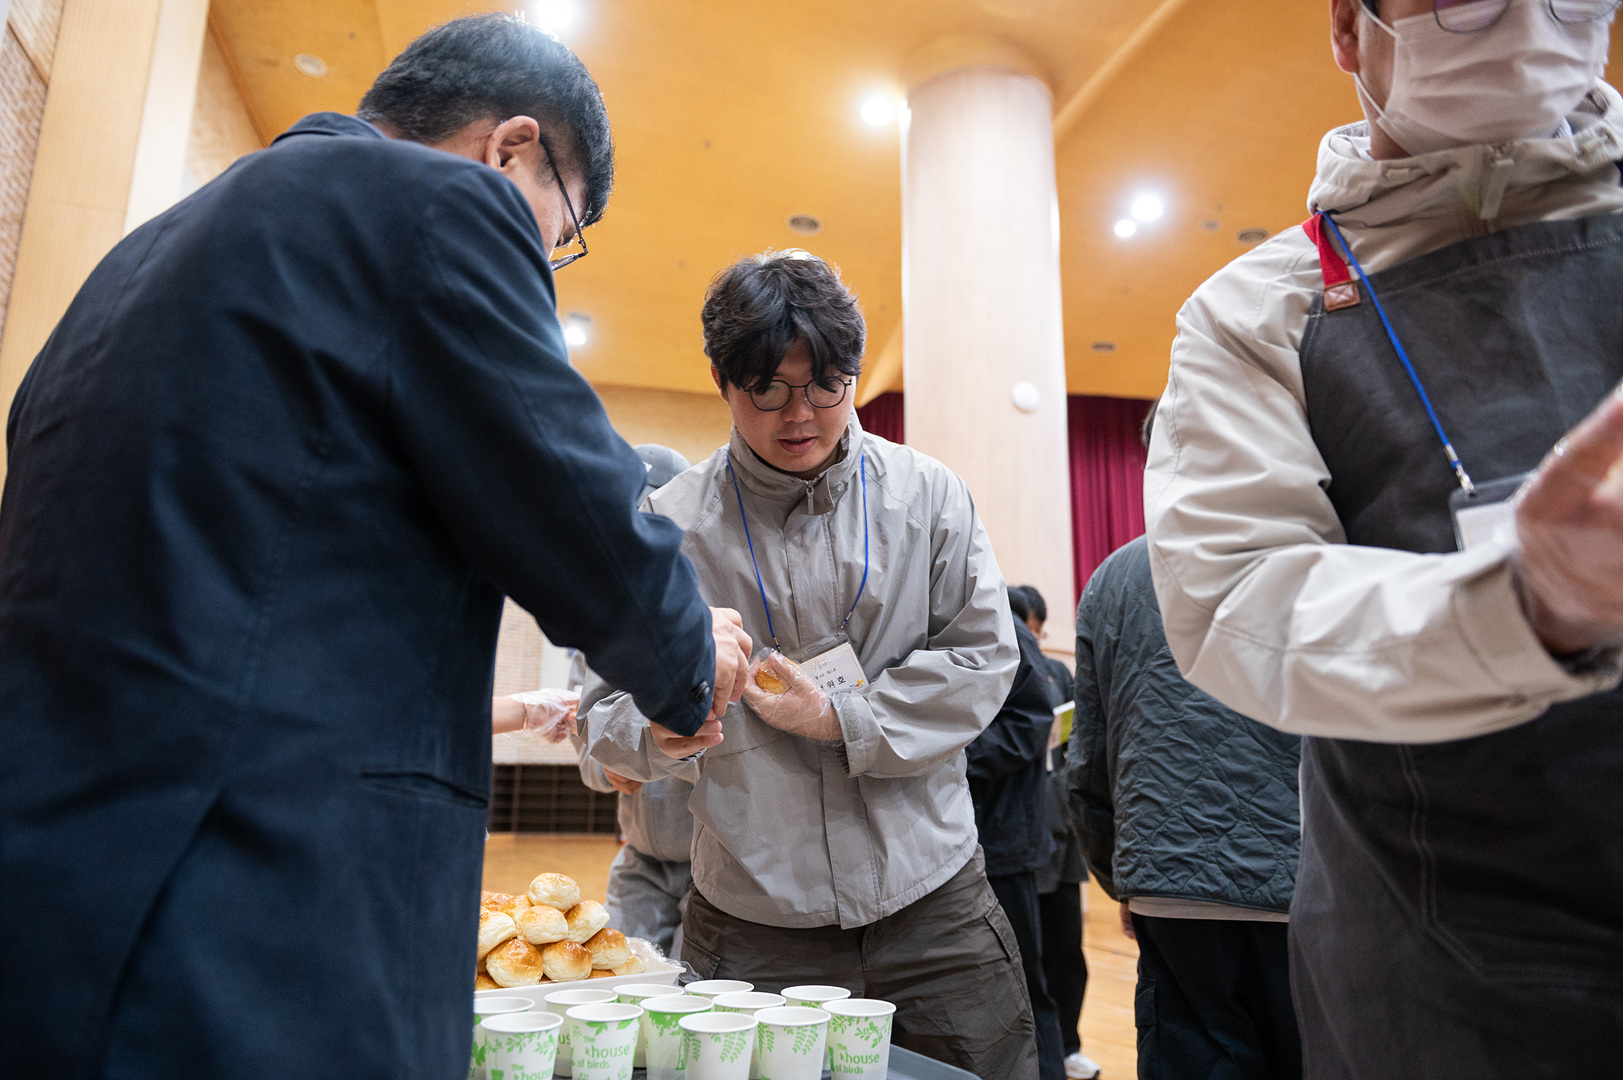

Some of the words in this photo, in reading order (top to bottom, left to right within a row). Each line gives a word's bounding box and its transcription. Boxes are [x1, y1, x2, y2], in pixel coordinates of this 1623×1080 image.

[584, 1035, 596, 1043] The
[591, 1045, 630, 1058] house
[837, 1043, 848, 1051] The
[845, 1051, 880, 1064] house
[511, 1063, 524, 1071] The
[587, 1060, 610, 1069] birds
[843, 1064, 864, 1074] birds
[521, 1067, 553, 1080] house
